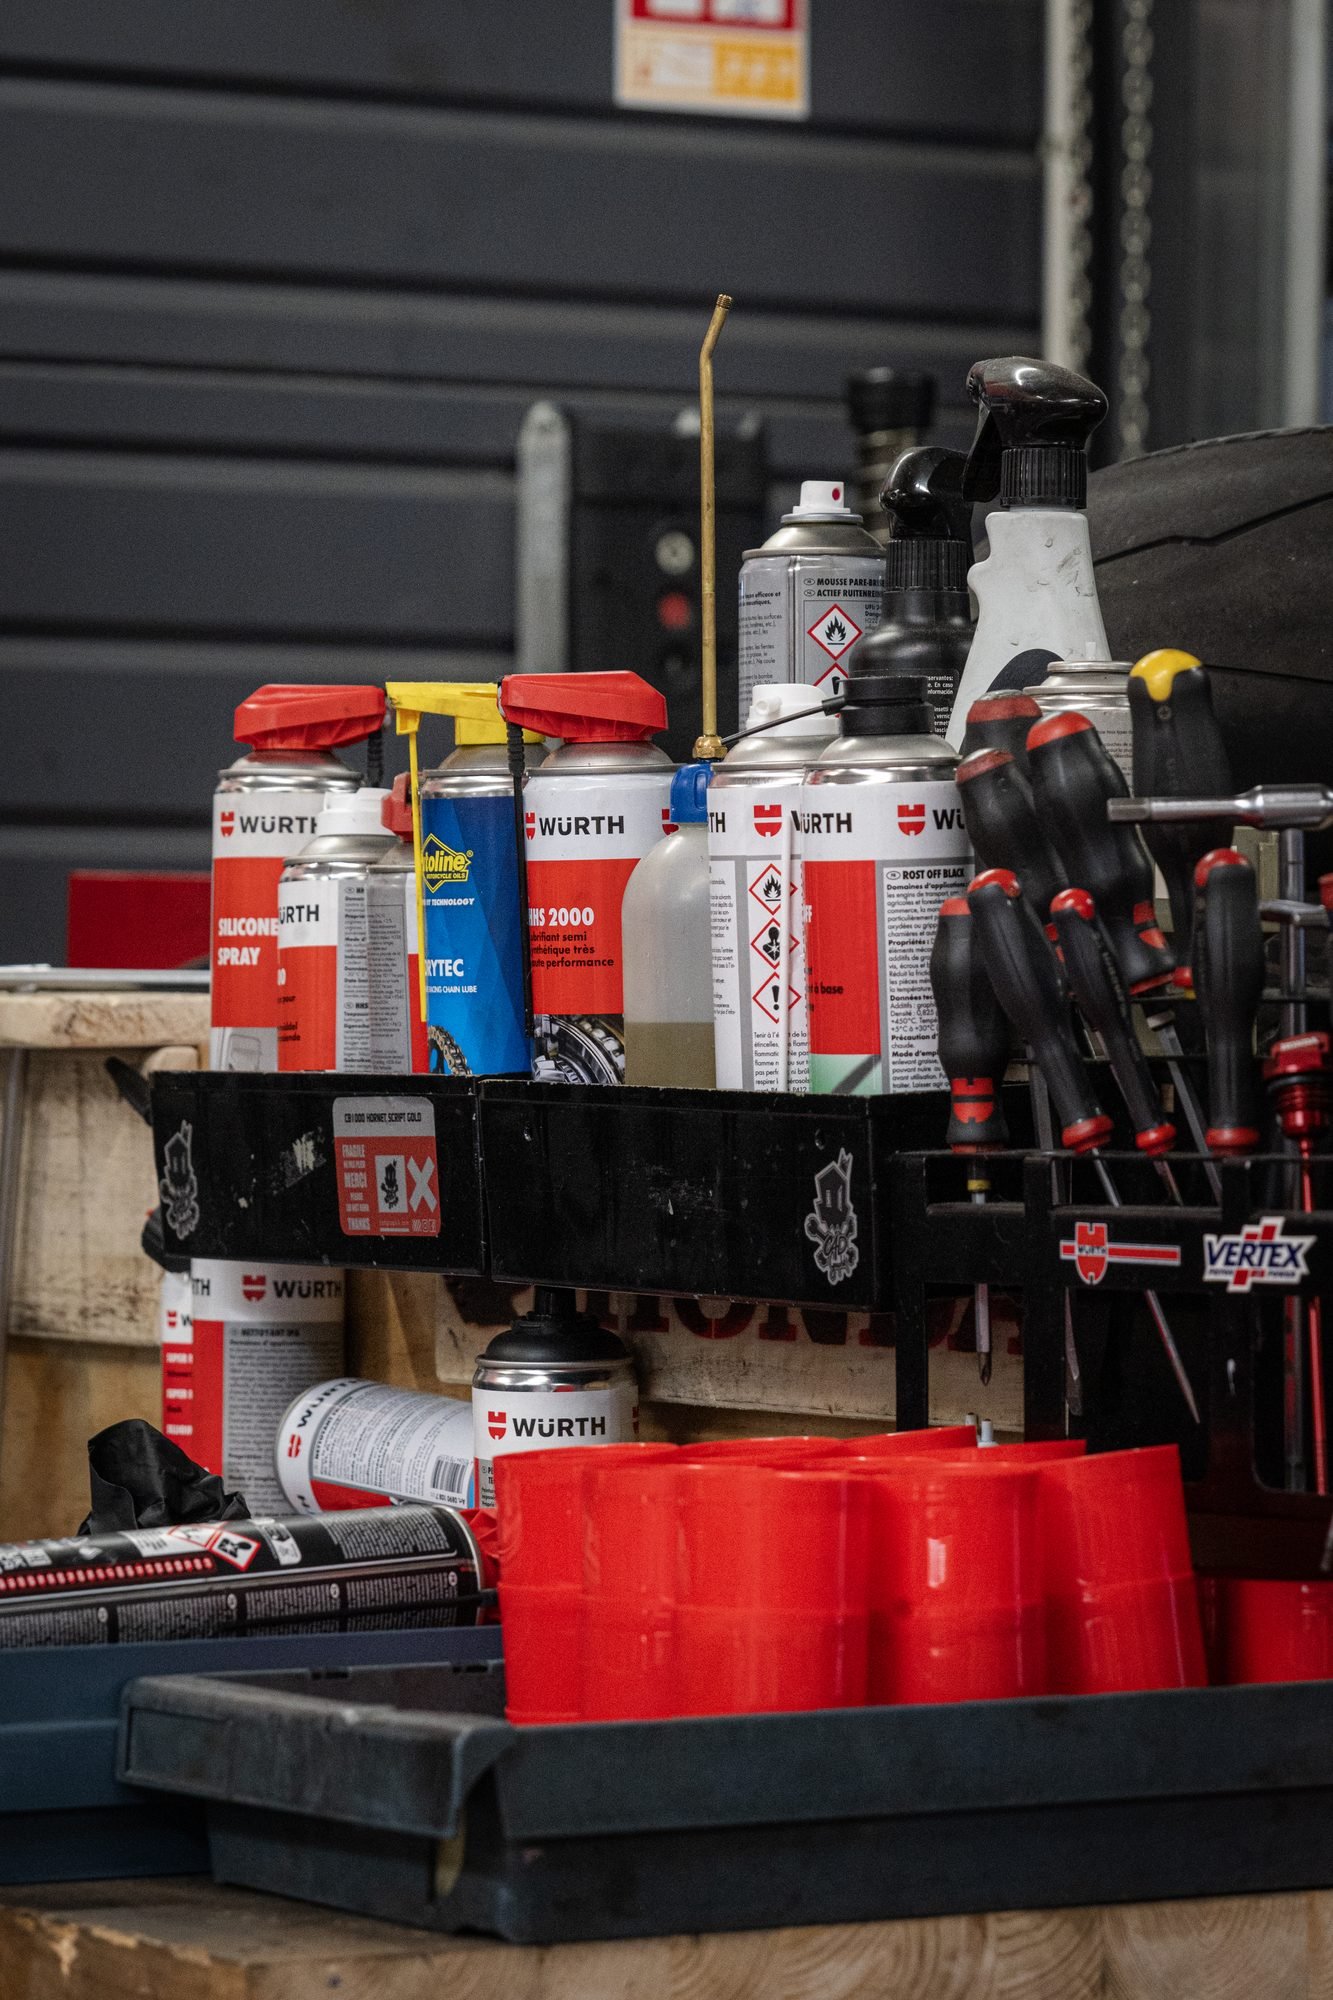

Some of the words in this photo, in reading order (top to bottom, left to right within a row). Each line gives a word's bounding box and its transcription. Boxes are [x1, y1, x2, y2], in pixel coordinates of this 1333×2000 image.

[816, 578, 848, 586] MOUSSE
[816, 589, 840, 597] ACTIEF
[539, 816, 624, 836] WÜRTH
[902, 870, 925, 880] ROST
[927, 869, 942, 878] OFF
[943, 868, 964, 878] BLACK
[432, 898, 475, 906] TECHNOLOGY
[548, 907, 594, 926] 2000
[218, 918, 278, 937] SILICONE
[562, 932, 587, 941] semi
[574, 944, 595, 954] très
[217, 947, 260, 966] SPRAY
[546, 957, 614, 969] performance
[820, 982, 844, 994] base
[367, 1113, 387, 1122] HORNET
[388, 1112, 406, 1122] SCRIPT
[407, 1112, 422, 1122] GOLD
[1208, 1242, 1304, 1268] VERTEX
[513, 1416, 606, 1438] WÜRTH
